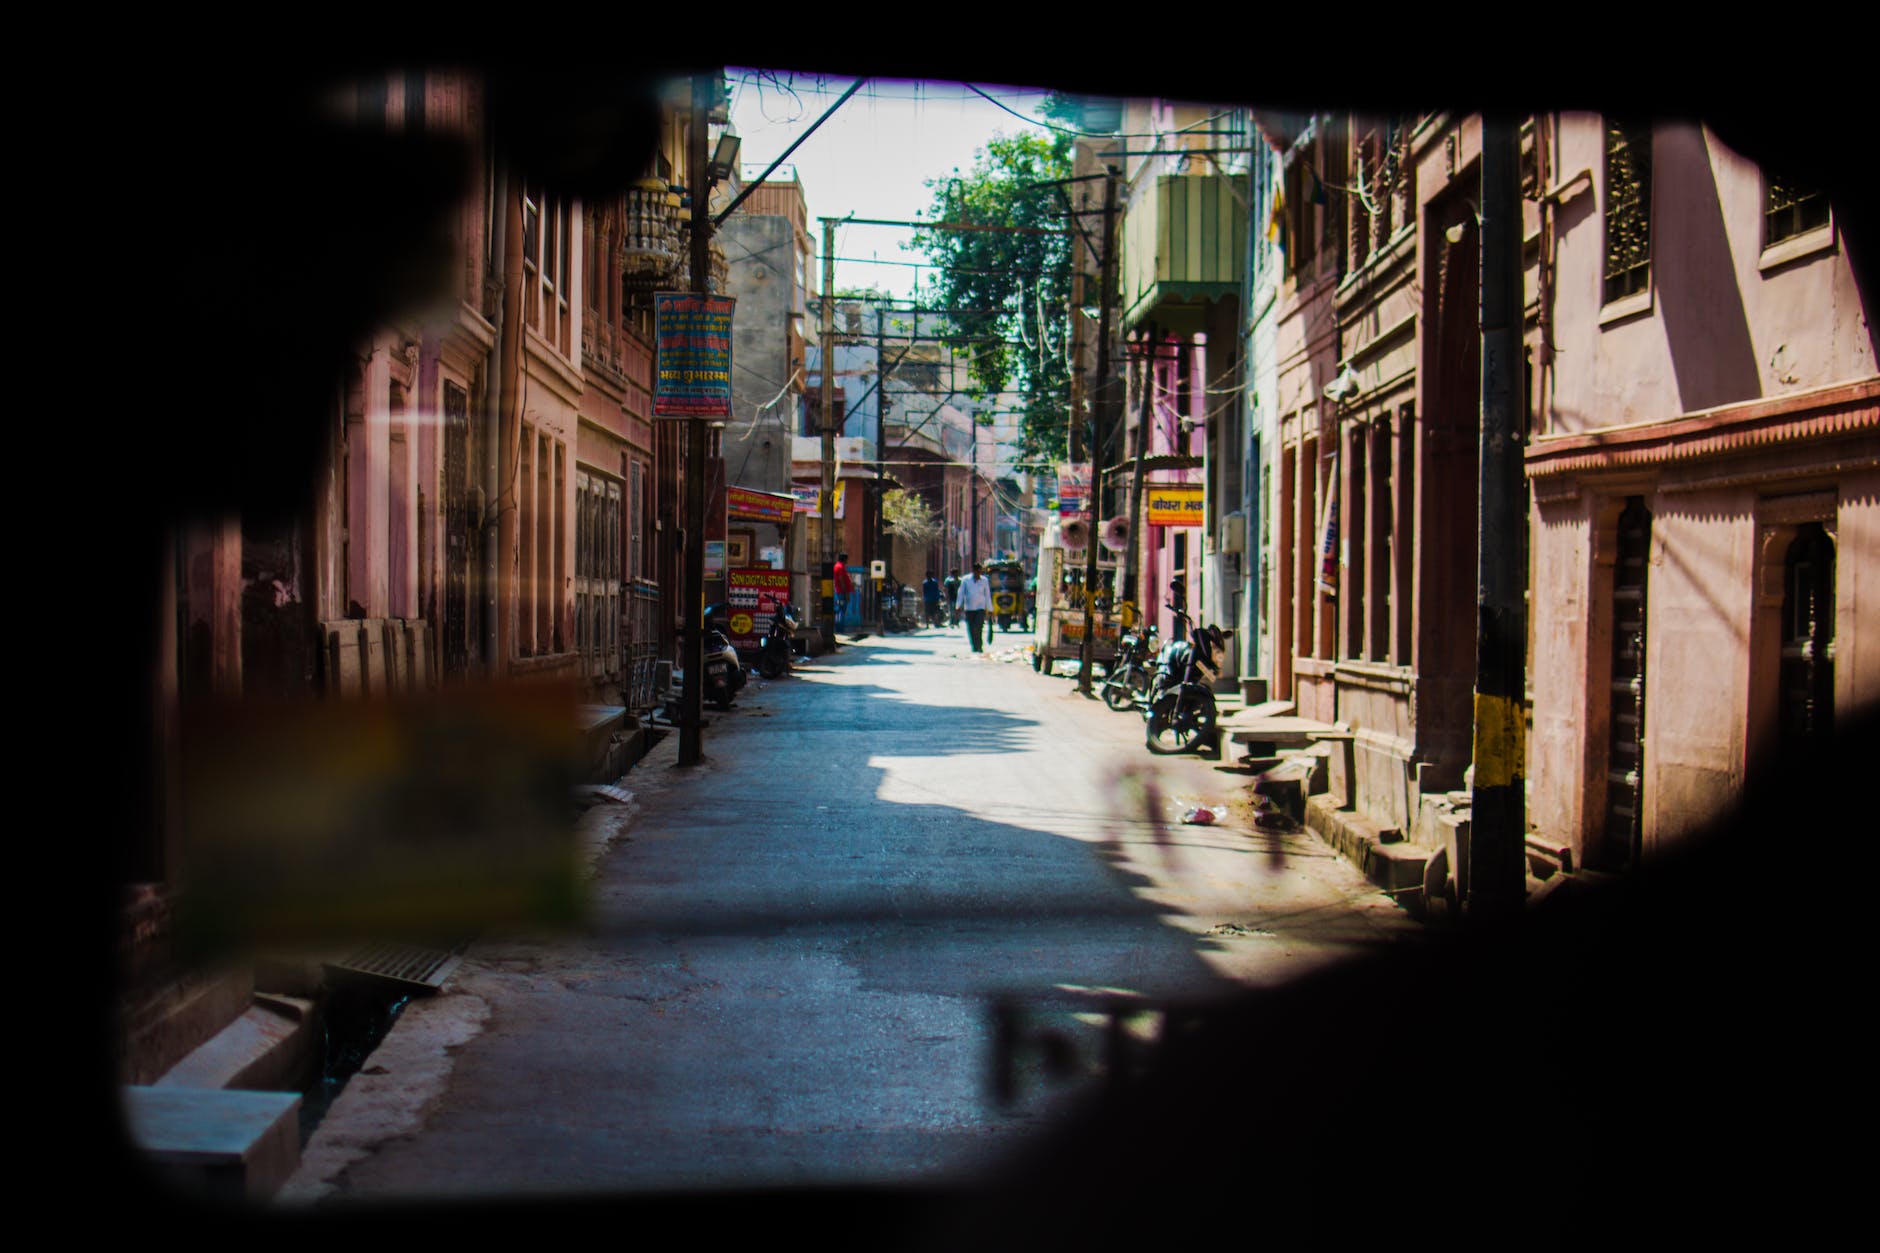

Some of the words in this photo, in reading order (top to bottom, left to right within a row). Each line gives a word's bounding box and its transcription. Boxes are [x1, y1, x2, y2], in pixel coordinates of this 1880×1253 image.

[731, 572, 745, 585] SONI
[745, 575, 767, 587] DIGITAL
[768, 575, 789, 588] STUDIO
